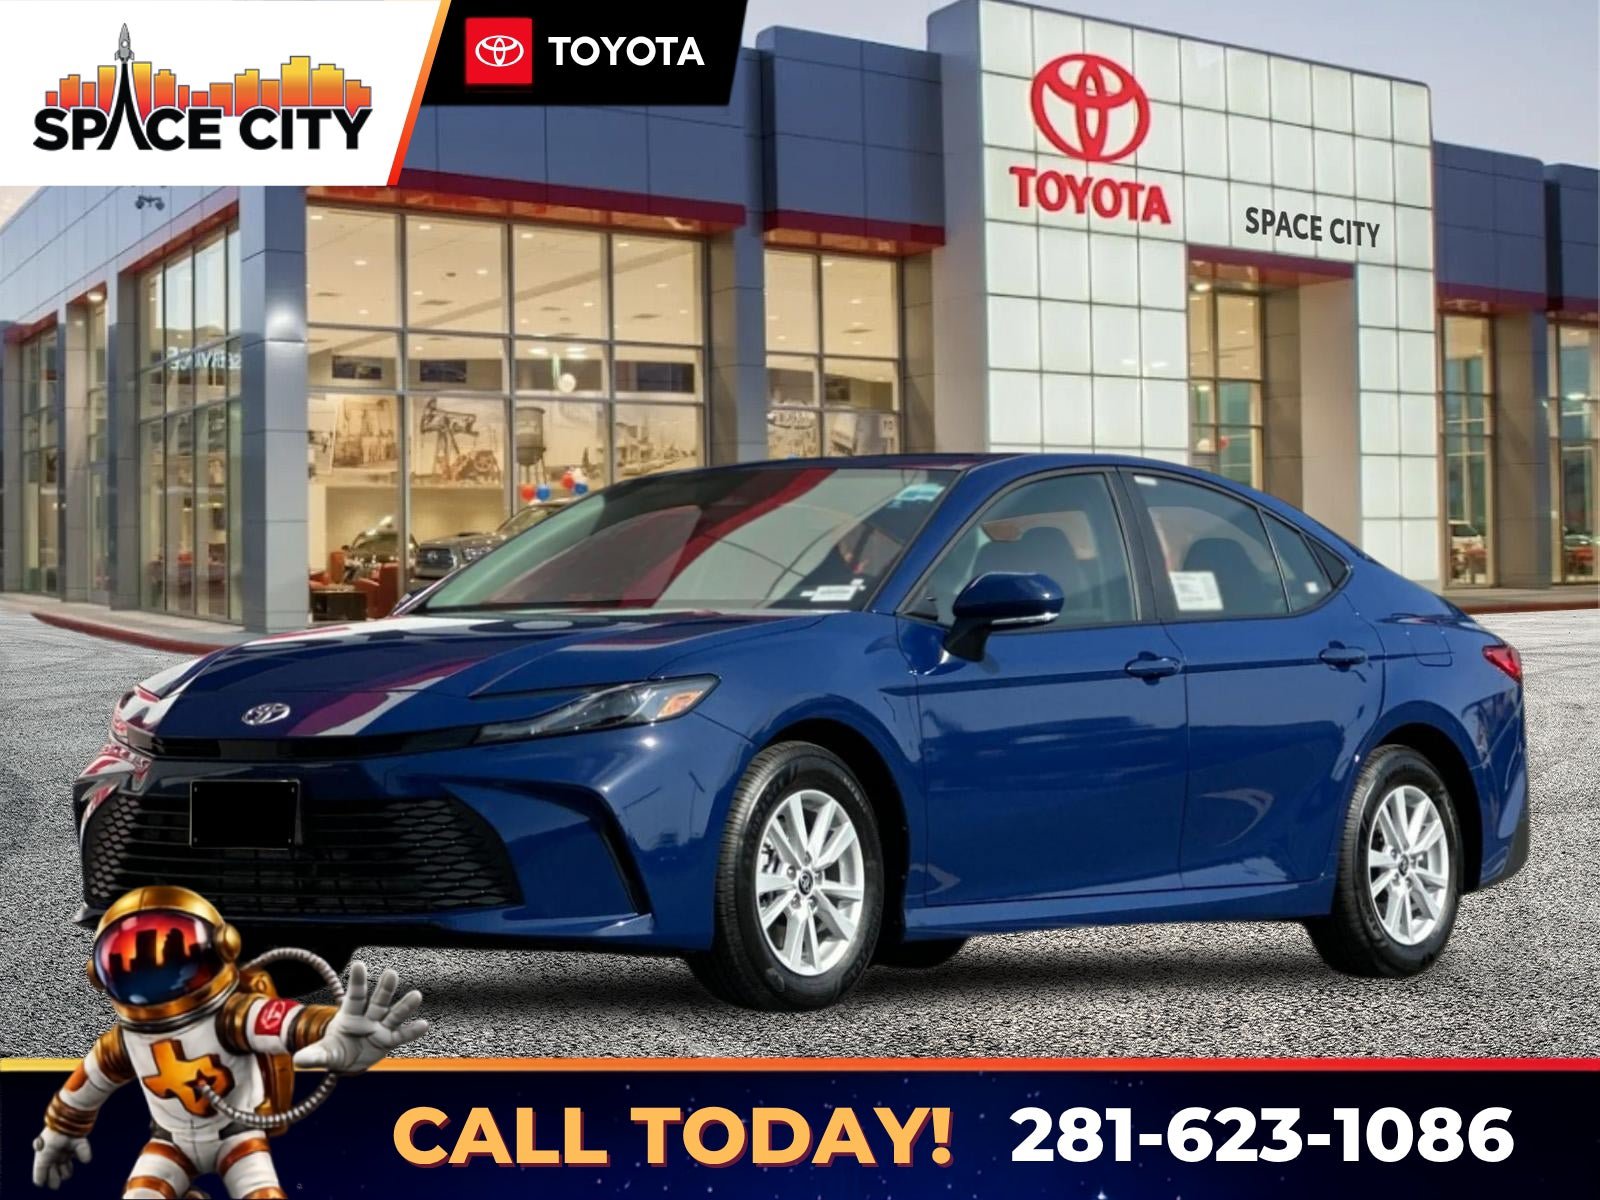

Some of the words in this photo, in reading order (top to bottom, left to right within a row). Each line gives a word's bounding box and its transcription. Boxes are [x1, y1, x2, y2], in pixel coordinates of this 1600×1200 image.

[1009, 165, 1171, 225] TOYOTA
[1245, 206, 1323, 242] SPACE
[1329, 217, 1381, 248] CITY
